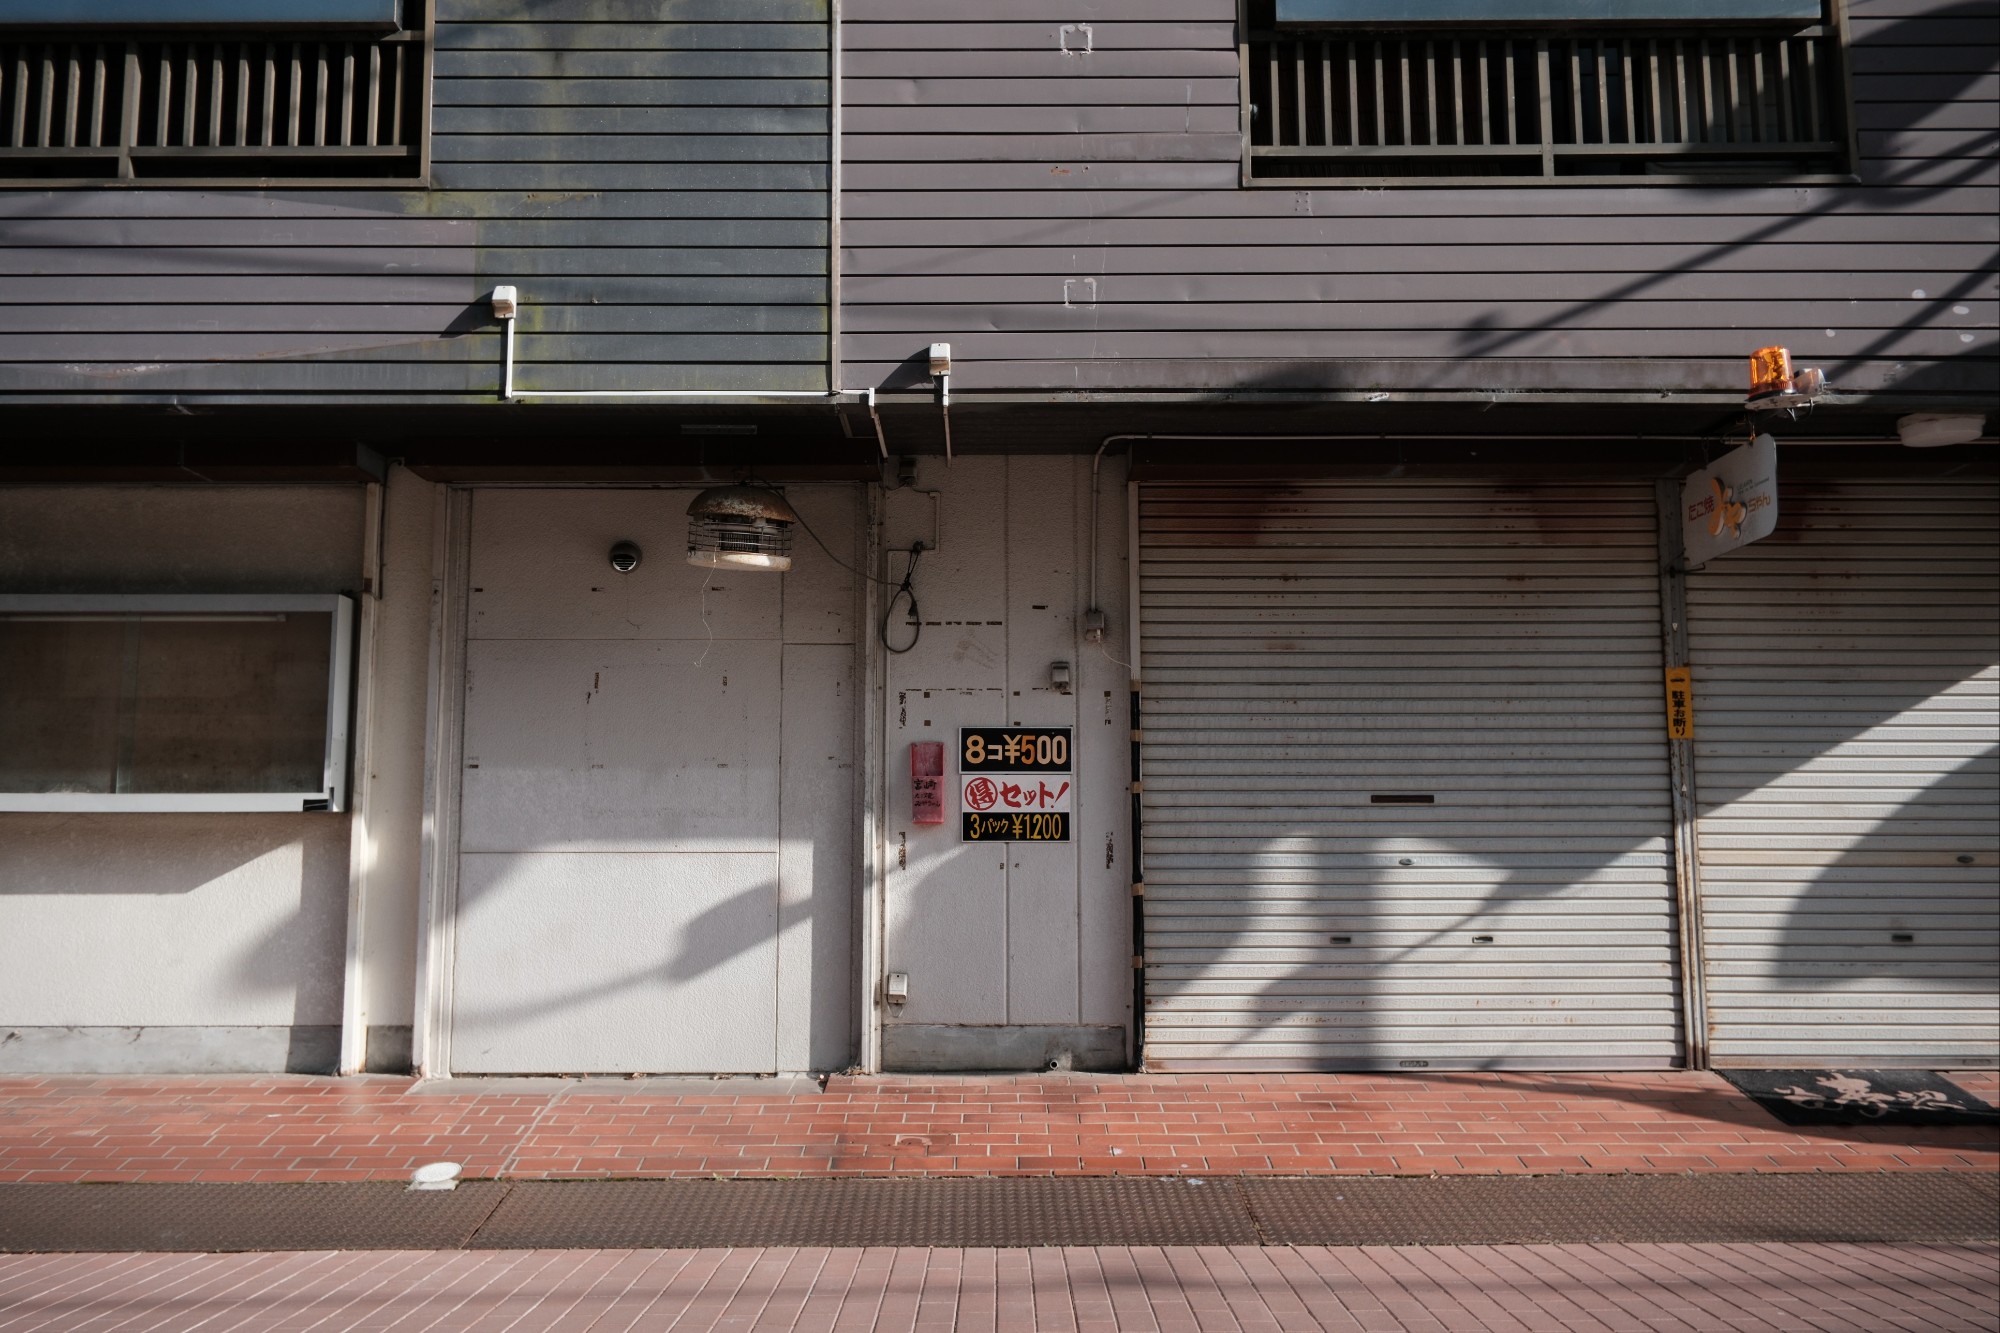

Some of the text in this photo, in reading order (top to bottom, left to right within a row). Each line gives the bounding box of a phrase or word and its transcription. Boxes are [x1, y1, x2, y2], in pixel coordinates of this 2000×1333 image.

[1671, 690, 1687, 736] 駐車お断り
